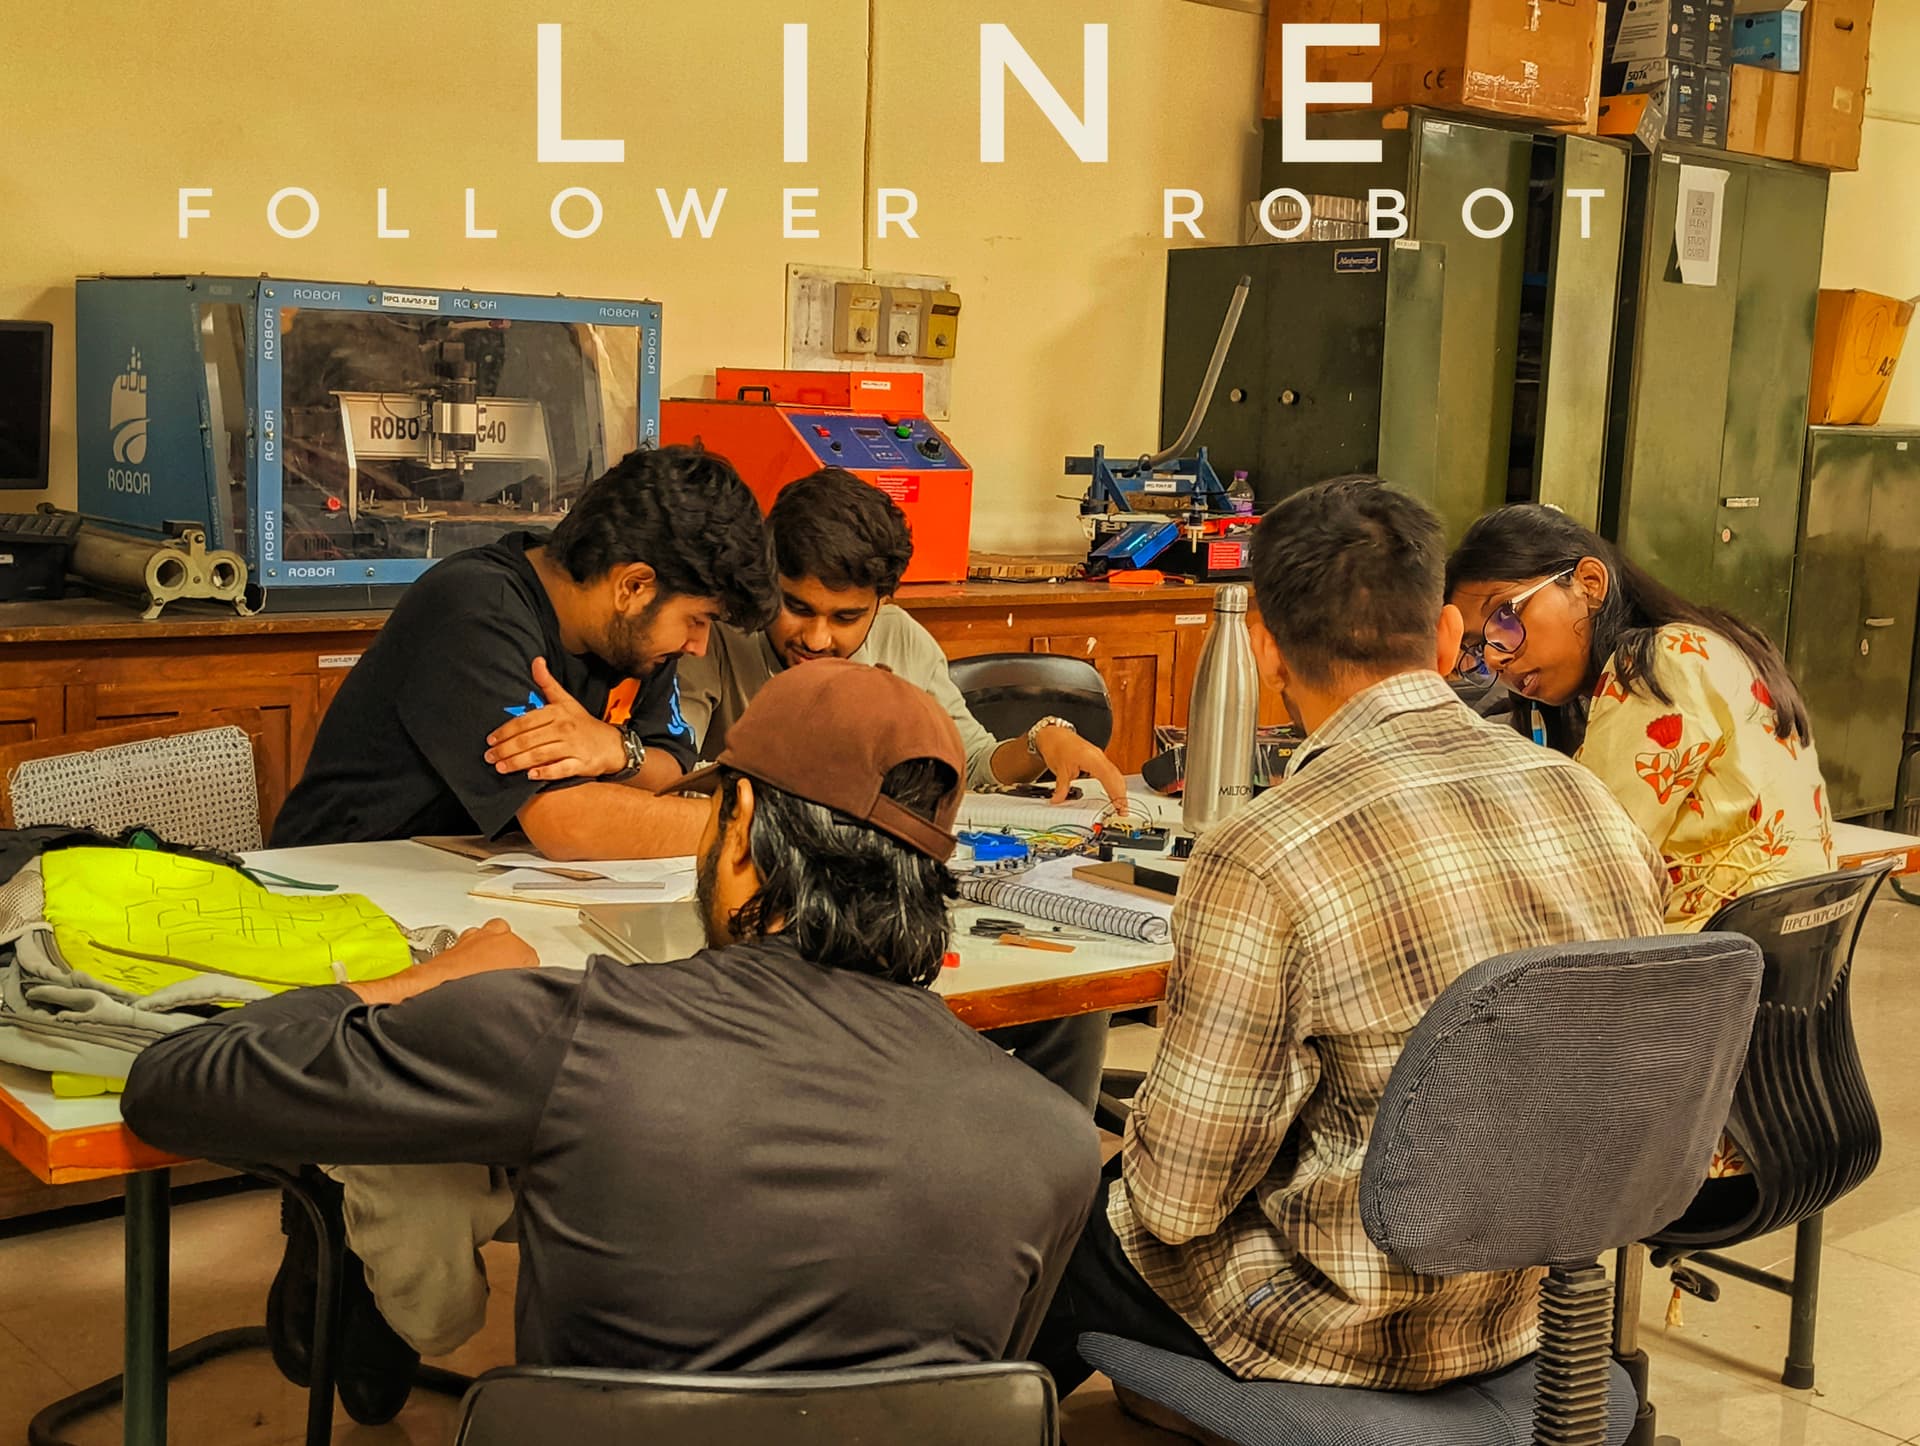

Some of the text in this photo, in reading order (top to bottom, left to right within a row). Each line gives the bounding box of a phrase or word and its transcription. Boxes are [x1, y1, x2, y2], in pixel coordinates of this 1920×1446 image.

[453, 298, 497, 310] ROOFI
[263, 410, 275, 462] ROOFI
[370, 415, 420, 441] ROBO
[288, 567, 336, 578] ROBOFI
